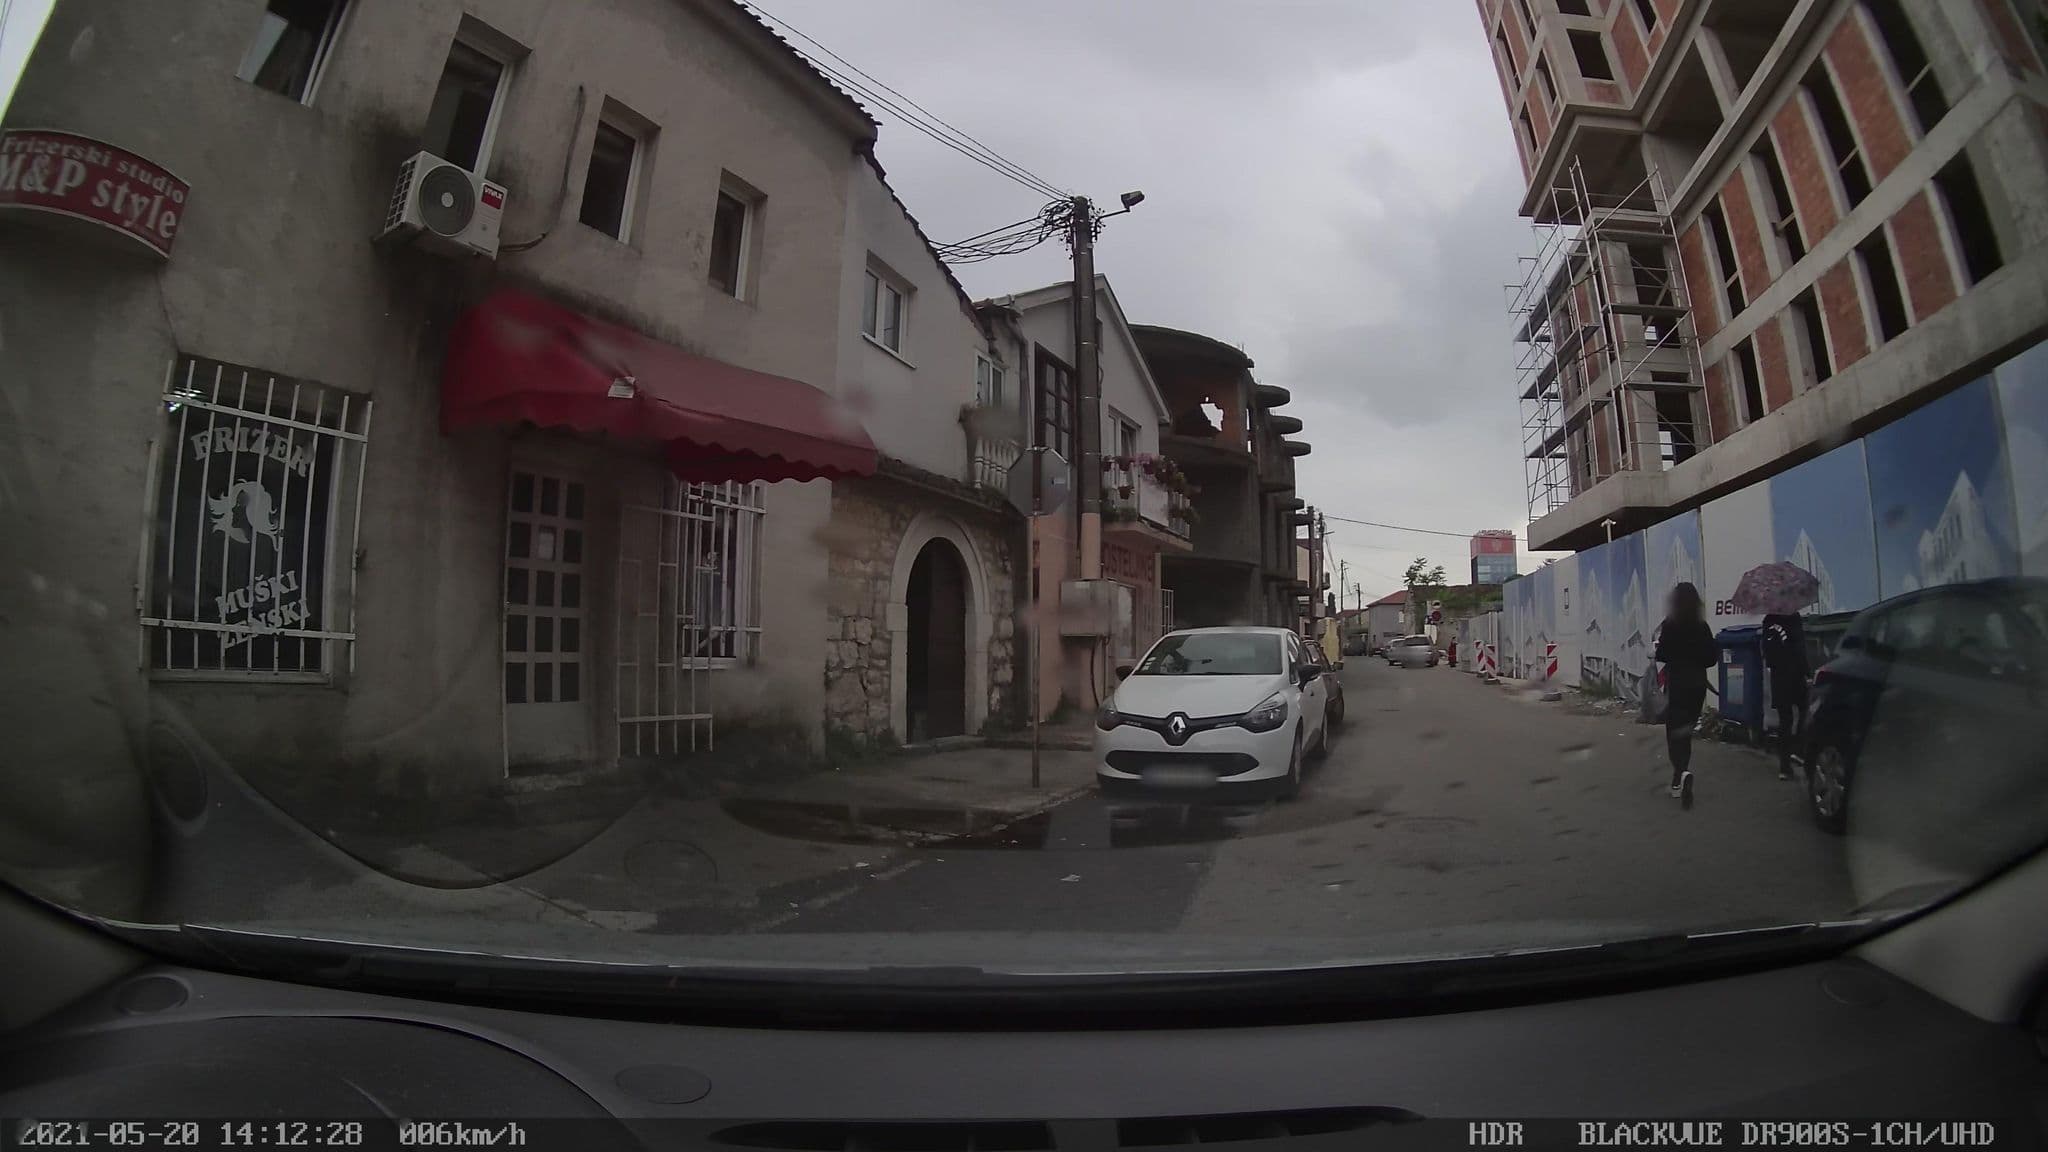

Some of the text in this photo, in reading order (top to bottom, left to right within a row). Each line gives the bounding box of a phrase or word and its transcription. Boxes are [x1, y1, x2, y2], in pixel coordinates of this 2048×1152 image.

[0, 152, 177, 239] M&P style
[2, 137, 184, 204] Frizerski studio
[215, 571, 298, 617] MUŠKI
